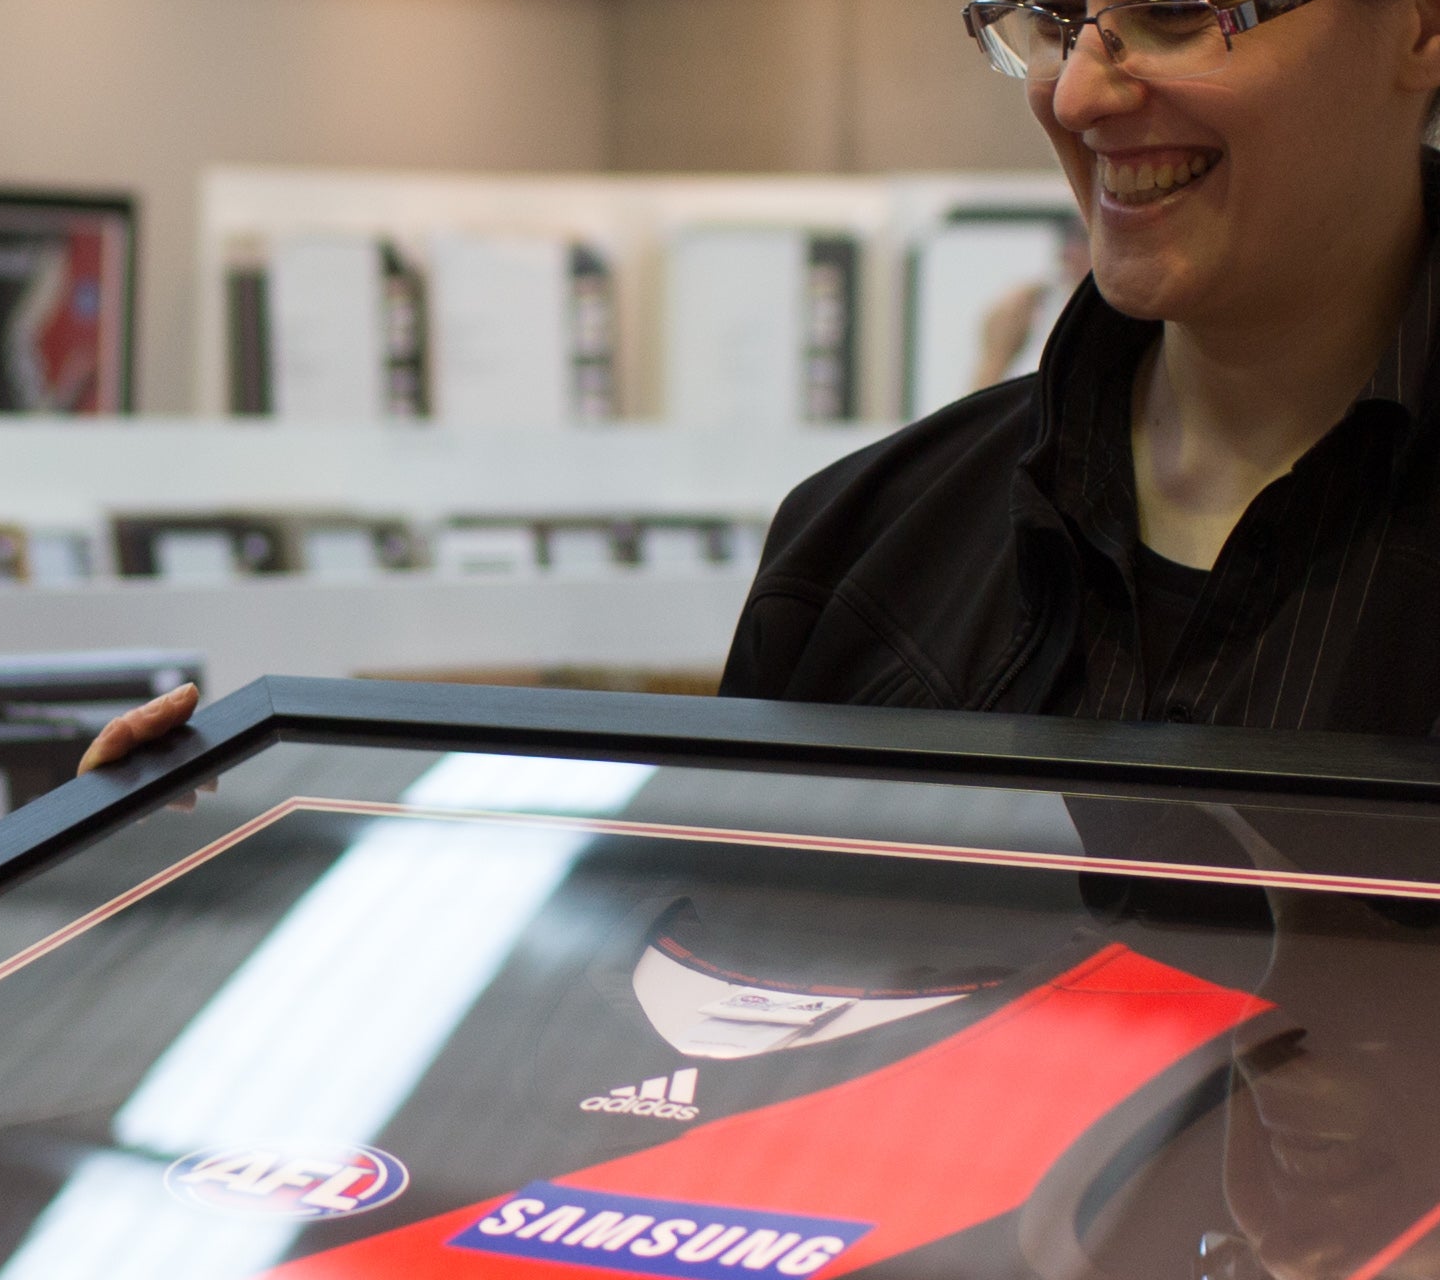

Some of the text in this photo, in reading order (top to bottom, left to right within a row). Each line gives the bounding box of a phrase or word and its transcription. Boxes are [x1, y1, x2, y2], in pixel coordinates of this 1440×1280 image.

[580, 1095, 700, 1120] adidas
[177, 1151, 378, 1210] AFL
[479, 1198, 844, 1275] SAMSUNG
